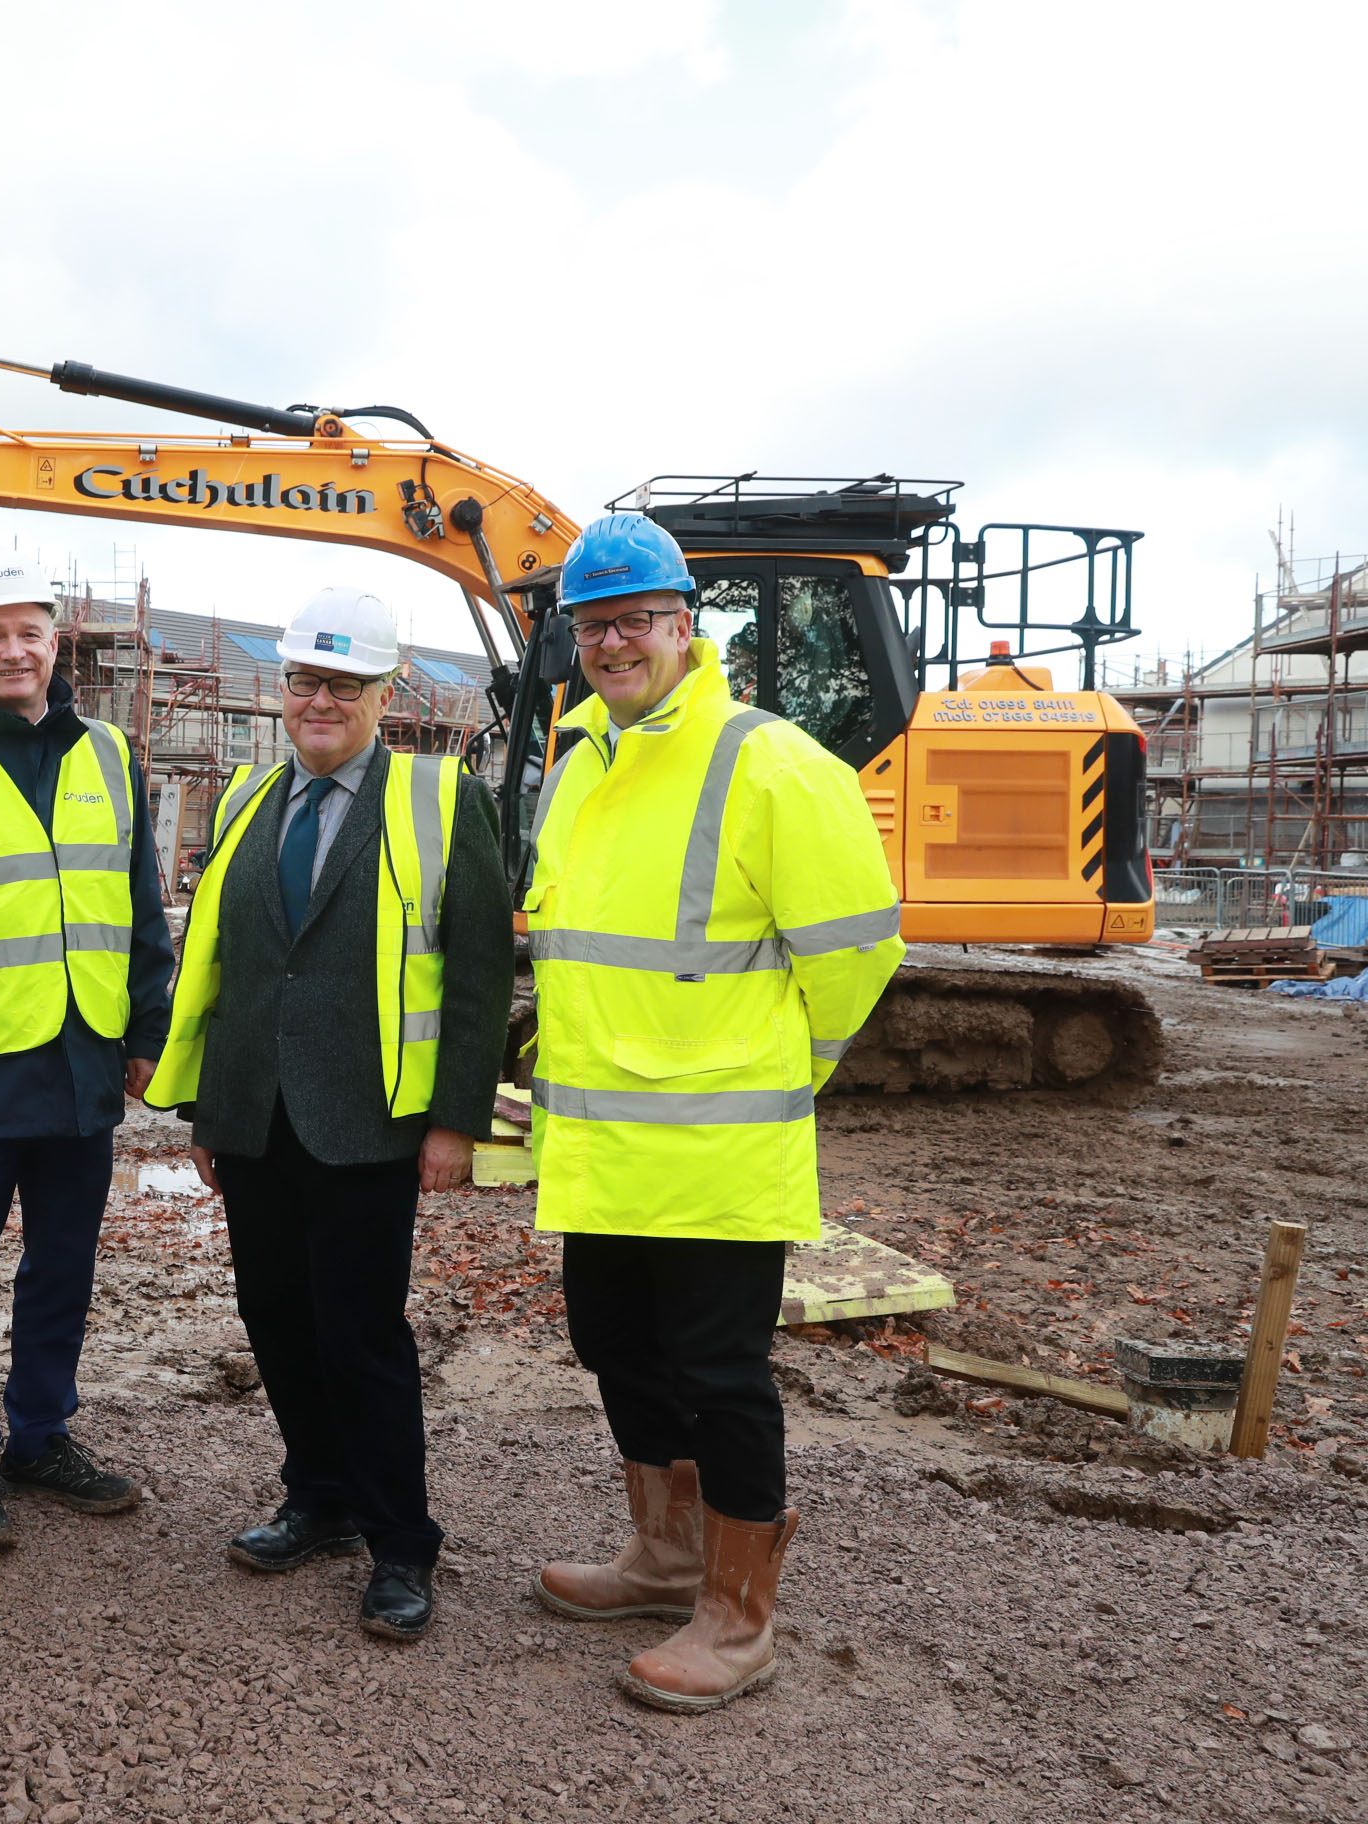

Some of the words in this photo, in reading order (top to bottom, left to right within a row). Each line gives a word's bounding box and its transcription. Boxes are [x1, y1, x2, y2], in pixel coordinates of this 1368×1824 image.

[979, 699, 1027, 710] 01698
[1033, 699, 1075, 710] 814111
[983, 711, 1033, 722] 07866
[1040, 711, 1096, 722] 045919
